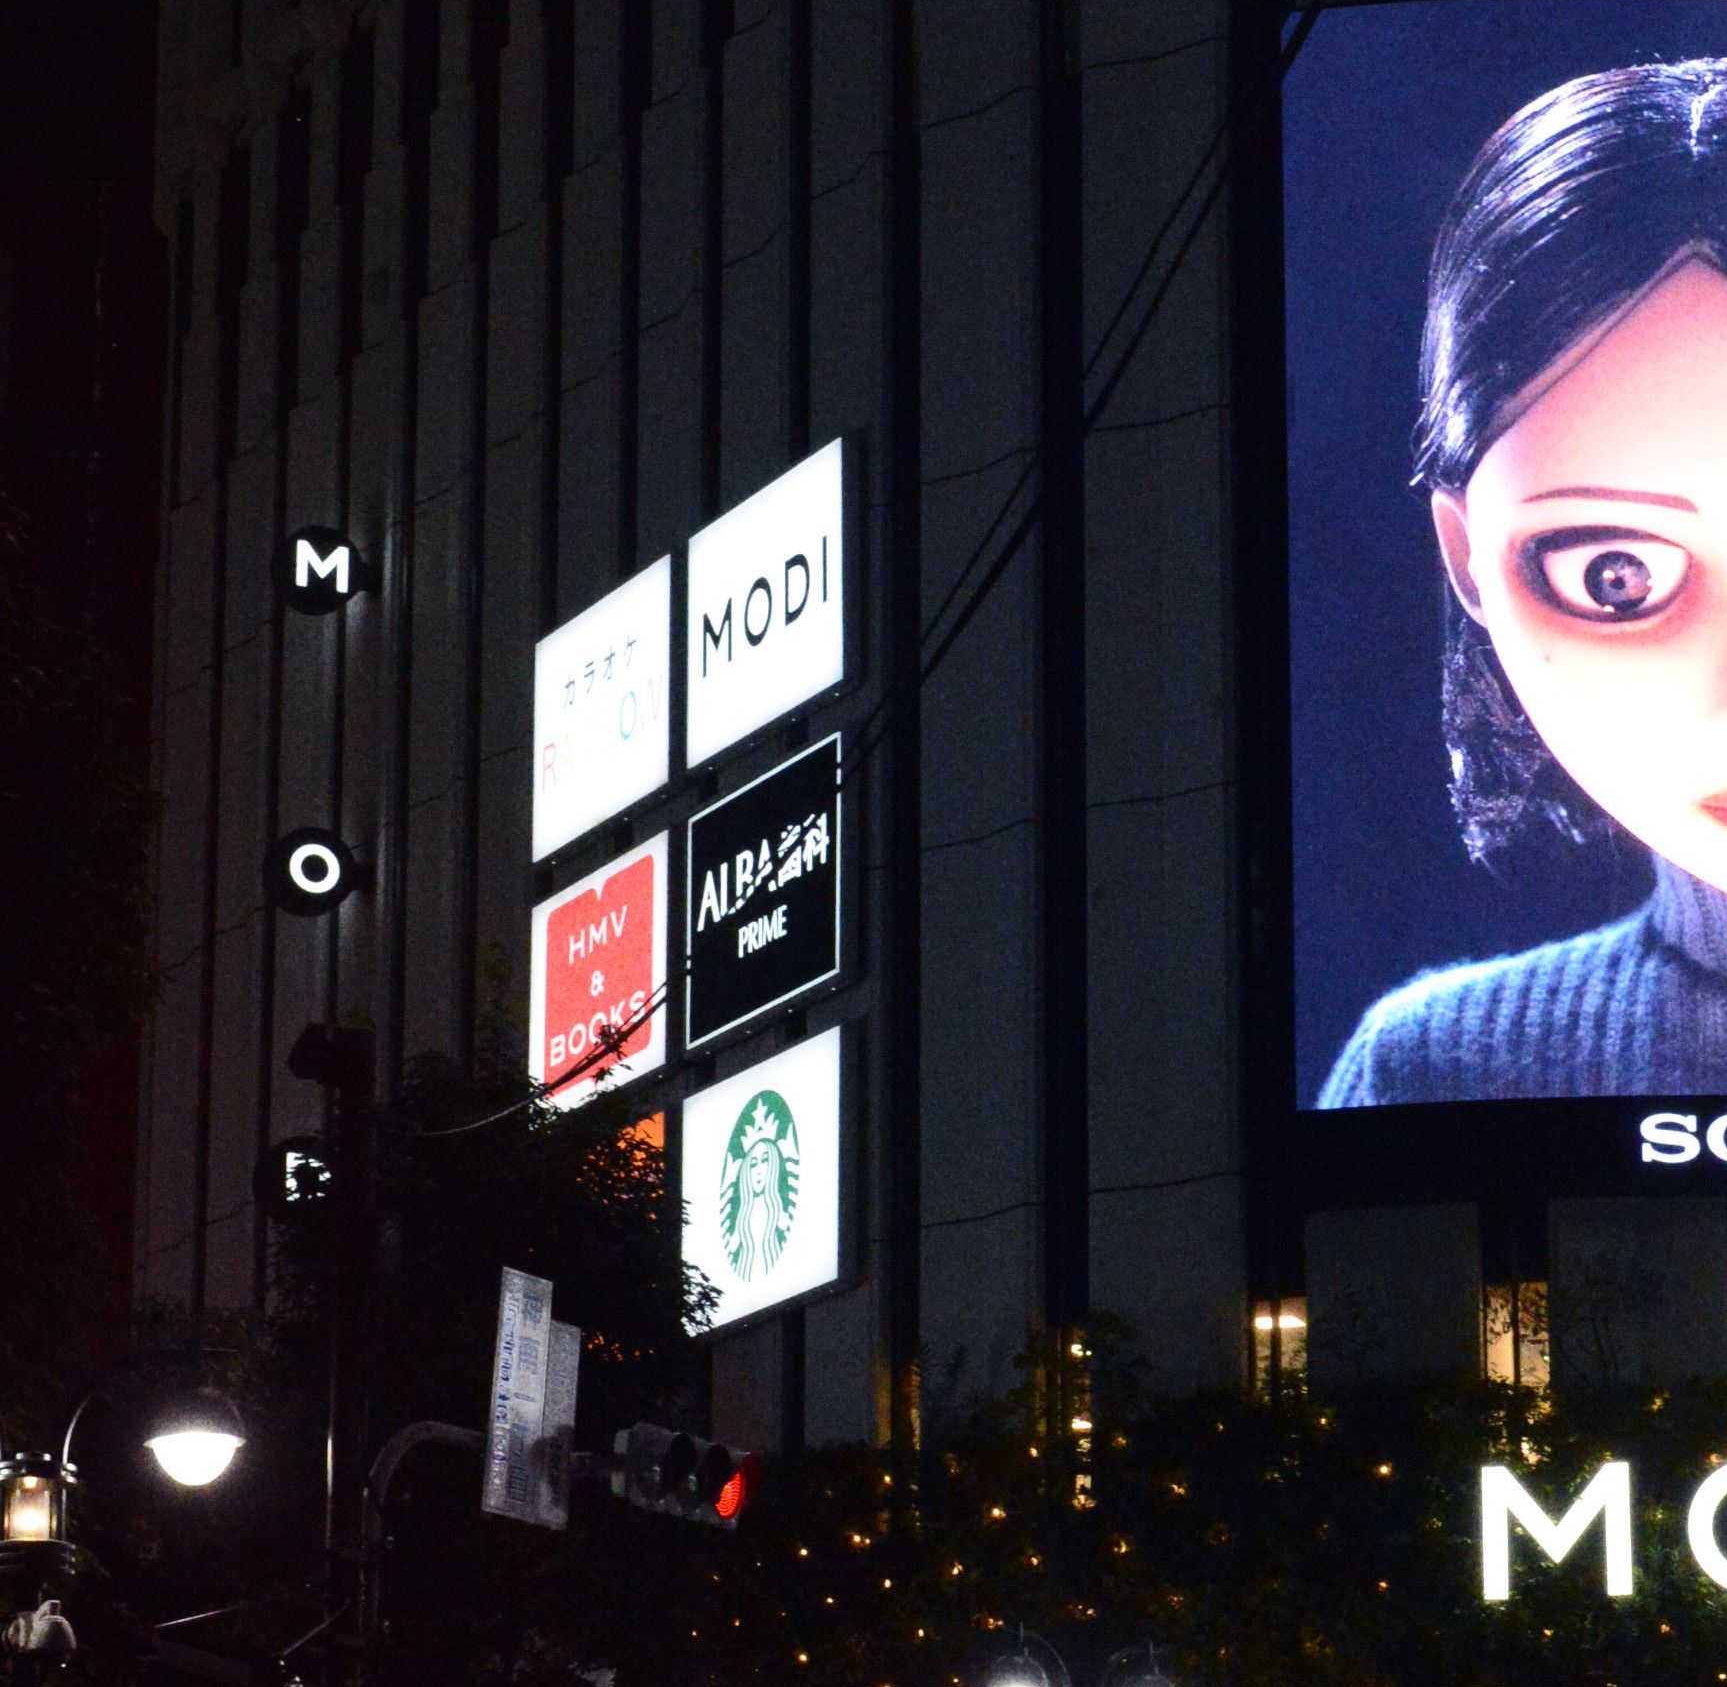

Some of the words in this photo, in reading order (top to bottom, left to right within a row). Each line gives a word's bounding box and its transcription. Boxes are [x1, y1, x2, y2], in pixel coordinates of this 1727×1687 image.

[295, 539, 350, 594] M
[702, 534, 828, 678] MODI
[562, 635, 638, 709] カラオケ
[540, 671, 664, 794] RAOW
[568, 905, 628, 965] HMV
[737, 904, 788, 959] PRIME
[589, 970, 605, 996] &
[549, 990, 648, 1067] BOOKS
